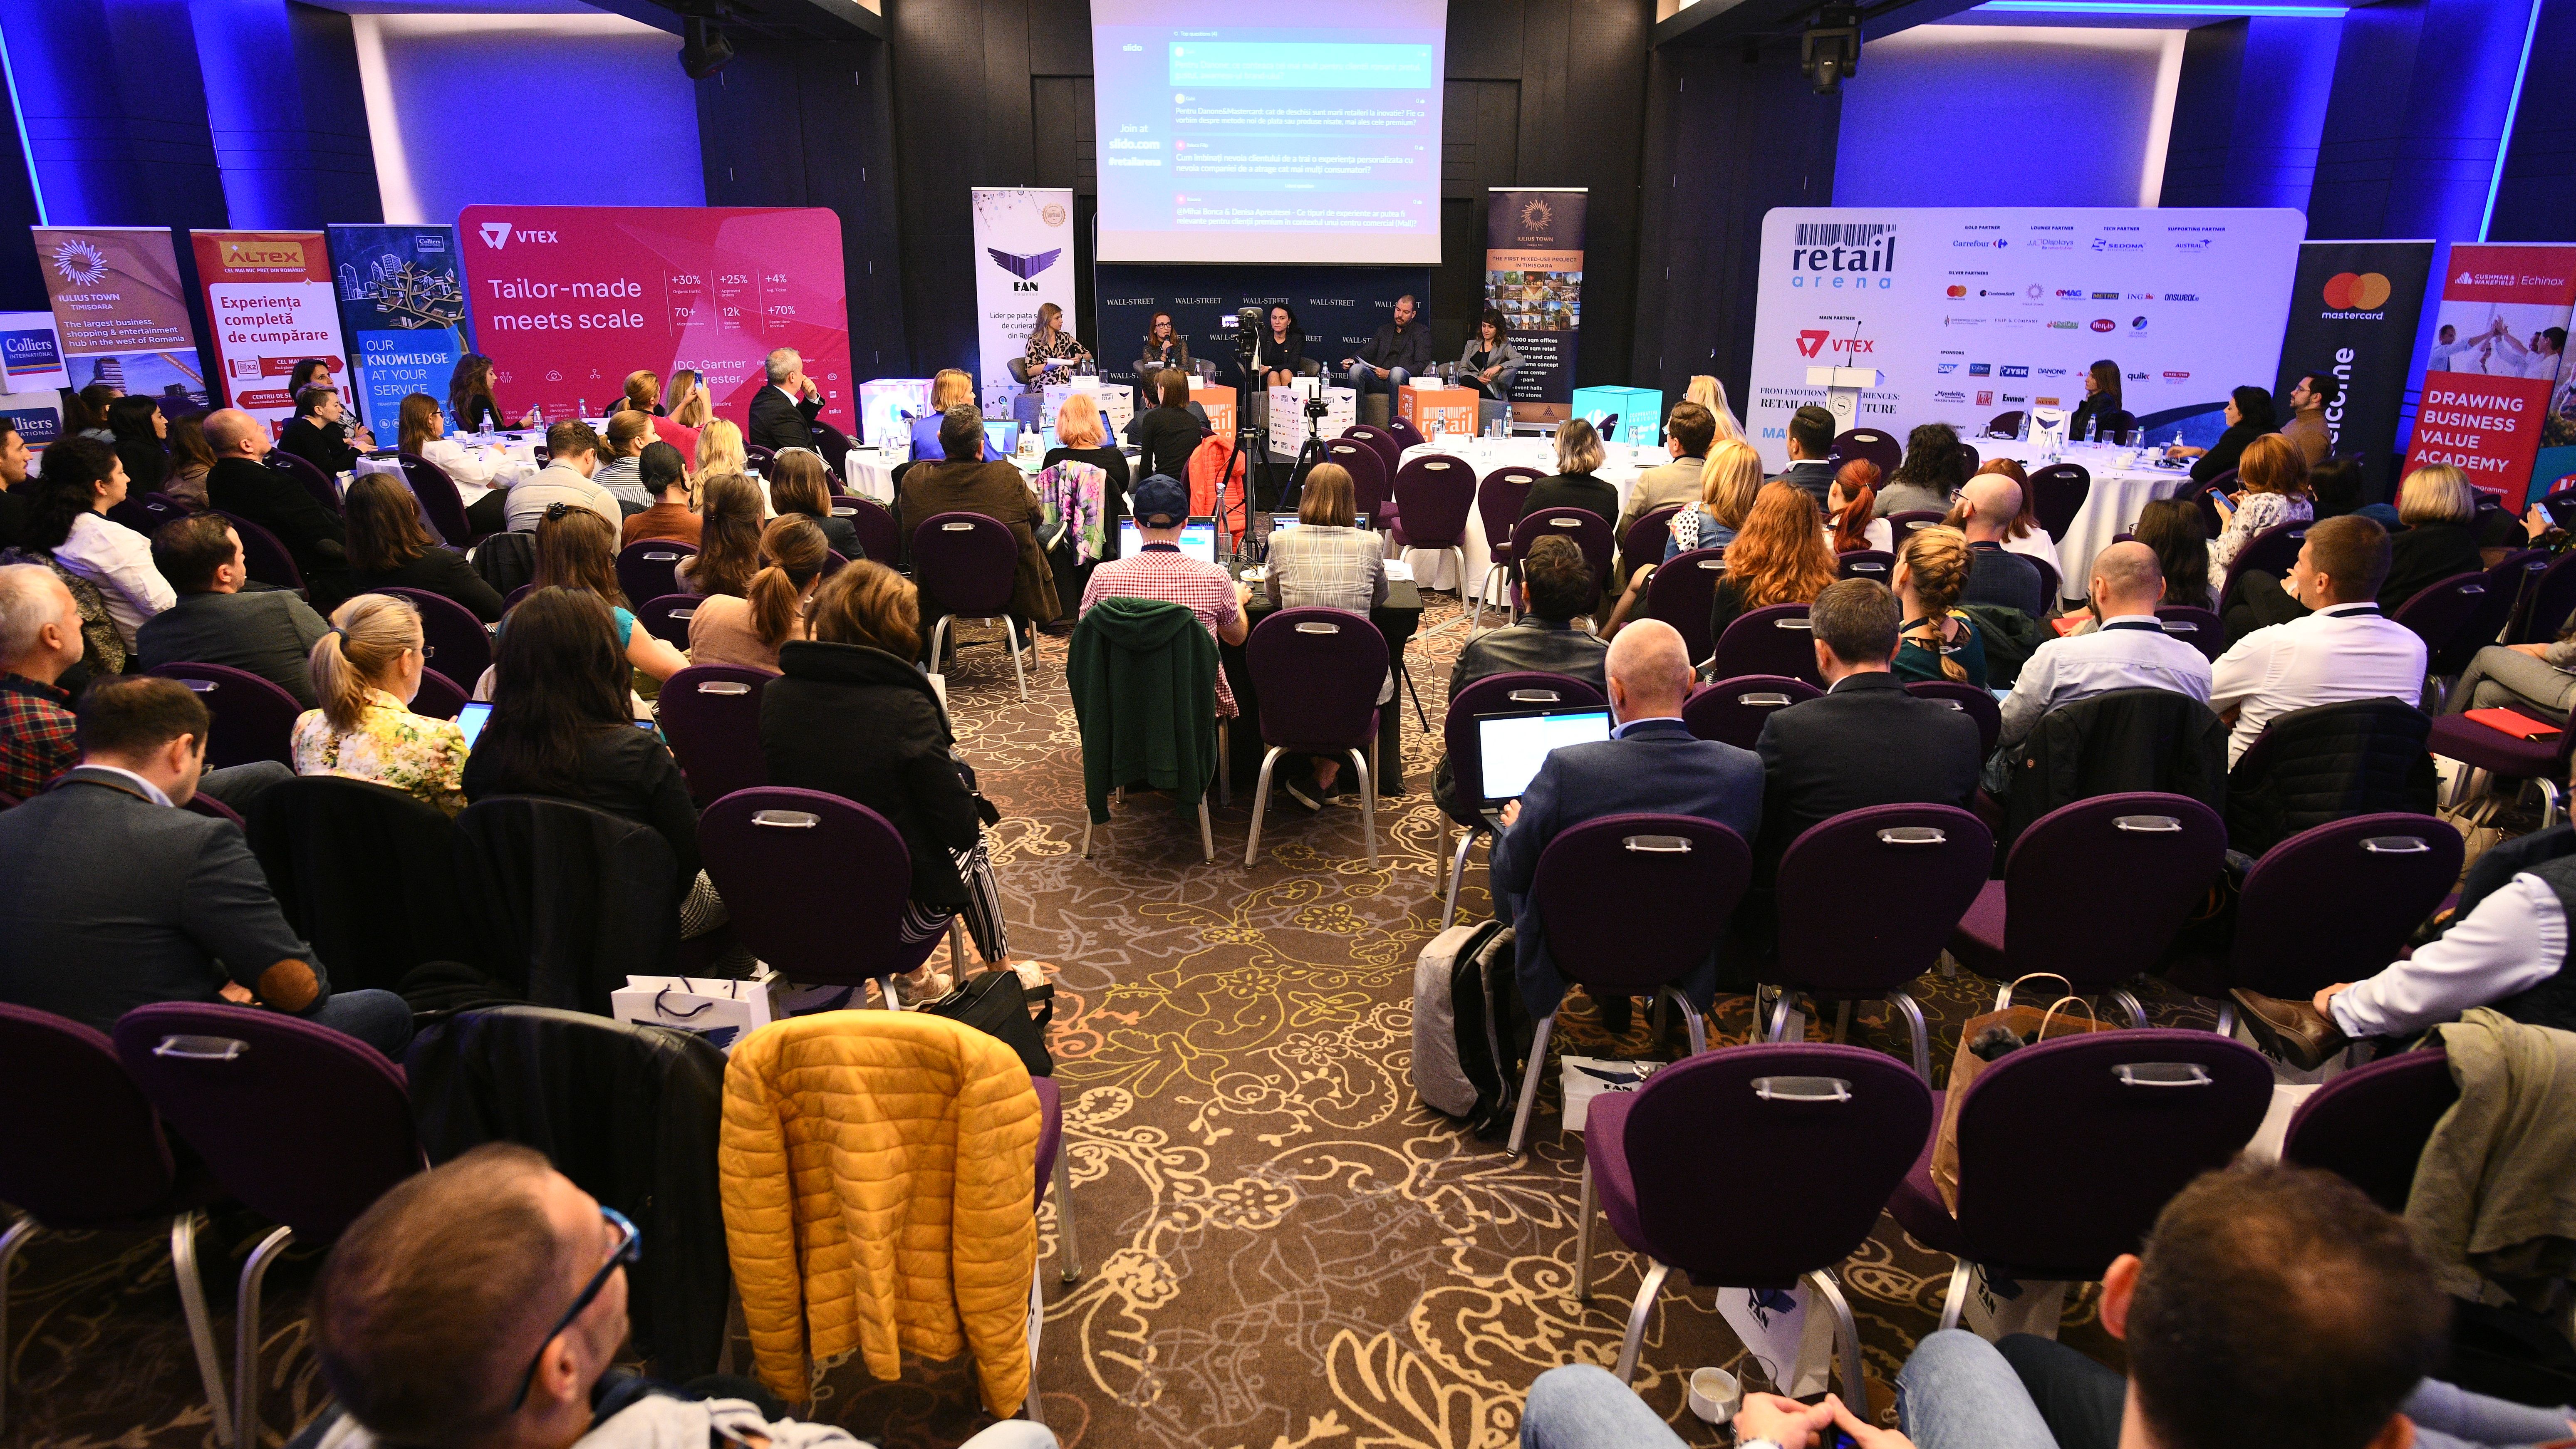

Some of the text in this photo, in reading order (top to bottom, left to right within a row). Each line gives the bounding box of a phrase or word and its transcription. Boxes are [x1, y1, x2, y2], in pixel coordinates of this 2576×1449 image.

[1120, 124, 1137, 133] Join
[1109, 138, 1160, 150] slido.com
[1108, 156, 1161, 167] #retailarena
[516, 230, 558, 243] VTEX
[1793, 236, 1895, 272] retail
[671, 275, 701, 285] +30%
[720, 275, 748, 284] +25%
[765, 274, 787, 283] +4%
[1792, 276, 1891, 289] arena
[2522, 276, 2564, 286] Echinox
[488, 277, 642, 299] Tailor-made
[1014, 282, 1038, 292] FAN
[221, 296, 301, 311] Experiența
[674, 307, 696, 317] 70+
[723, 307, 741, 316] 12k
[768, 305, 795, 315] +70%
[225, 312, 293, 328] completă
[493, 309, 644, 330] meets scale
[1017, 313, 1032, 321] piața
[67, 329, 108, 338] shopping
[119, 327, 178, 335] entertainment
[228, 329, 328, 344] de cumpărare
[6, 337, 52, 352] Colliers
[366, 340, 394, 351] OUR
[1833, 339, 1874, 352] VTEX
[367, 353, 449, 366] KNOWLEDGE
[701, 360, 746, 369] Gartner
[372, 369, 427, 381] AT YOUR
[374, 384, 429, 396] SERVICE
[1761, 399, 1798, 409] RETAIL
[2002, 394, 2024, 402] ENVIRON
[2428, 390, 2523, 412] DRAWING
[2424, 410, 2515, 432] BUSINESS
[2421, 429, 2480, 449] VALUE
[2414, 449, 2509, 473] ACADEMY
[1978, 1282, 1996, 1315] FAN
[1748, 1295, 1769, 1329] FAN
